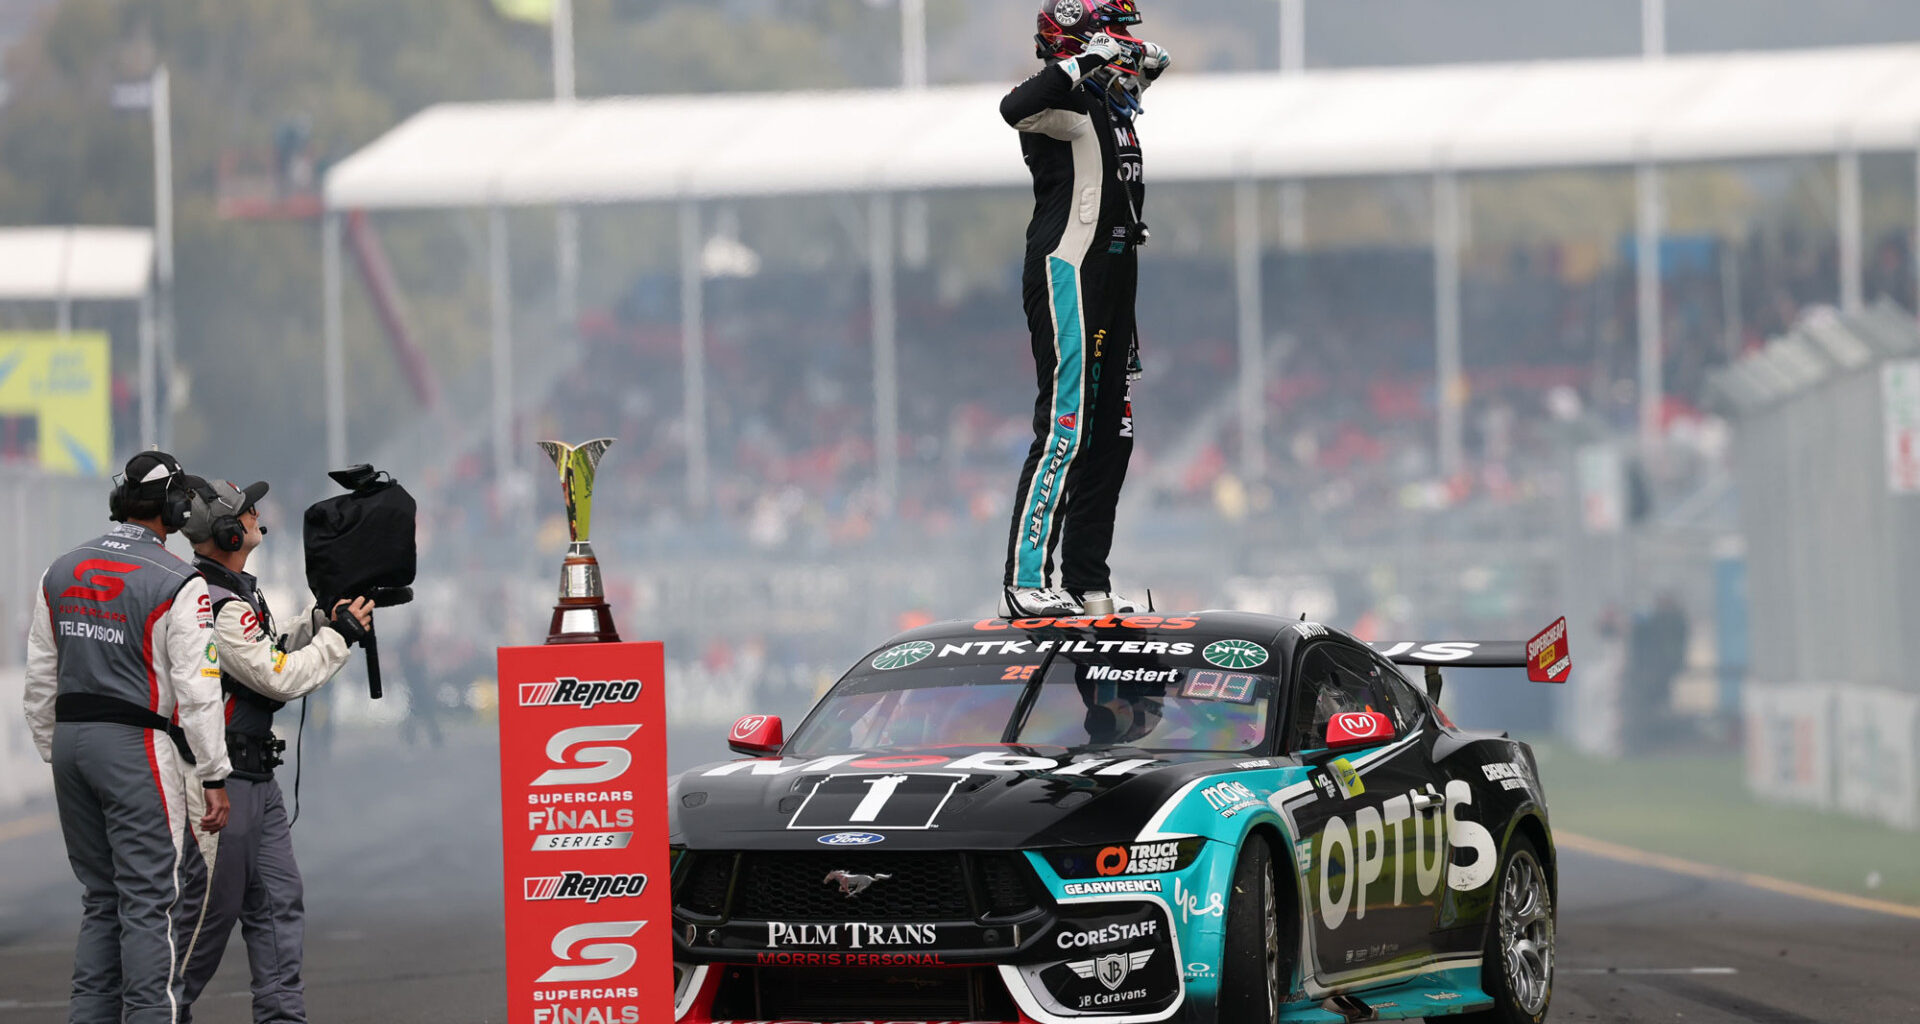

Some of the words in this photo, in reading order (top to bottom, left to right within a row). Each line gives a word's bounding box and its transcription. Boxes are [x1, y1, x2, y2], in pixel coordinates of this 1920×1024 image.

[59, 604, 128, 623] SUPERCARS
[973, 613, 1201, 631] Coates
[59, 621, 124, 645] TELEVISION
[1528, 619, 1565, 661] SUPERCHEAP
[884, 646, 926, 658] NTK
[937, 641, 1033, 657] NTK
[1034, 640, 1195, 656] FILTERS
[1214, 646, 1259, 657] NTK
[1001, 665, 1041, 680] 25
[1085, 665, 1178, 683] Mostert
[551, 677, 642, 709] Repco
[1344, 716, 1370, 729] M
[699, 752, 1157, 776] Mobil
[528, 791, 633, 804] SUPERCARS
[849, 775, 909, 822] 1
[1200, 780, 1256, 811] move
[528, 807, 634, 830] FINALS
[549, 834, 615, 848] SERIES
[1129, 842, 1179, 860] TRUCK
[1319, 779, 1497, 930] OPTUS
[1125, 857, 1177, 874] ASSIST
[556, 872, 647, 903] Repco
[1064, 880, 1162, 895] GEARWRENCH
[766, 922, 838, 948] PALM
[844, 922, 937, 948] TRANS
[757, 952, 842, 966] MORRIS
[845, 953, 946, 966] PERSONAL
[533, 987, 639, 1001] SUPERCARS
[1094, 988, 1147, 1006] Caravans
[534, 1003, 640, 1024] FINALS
